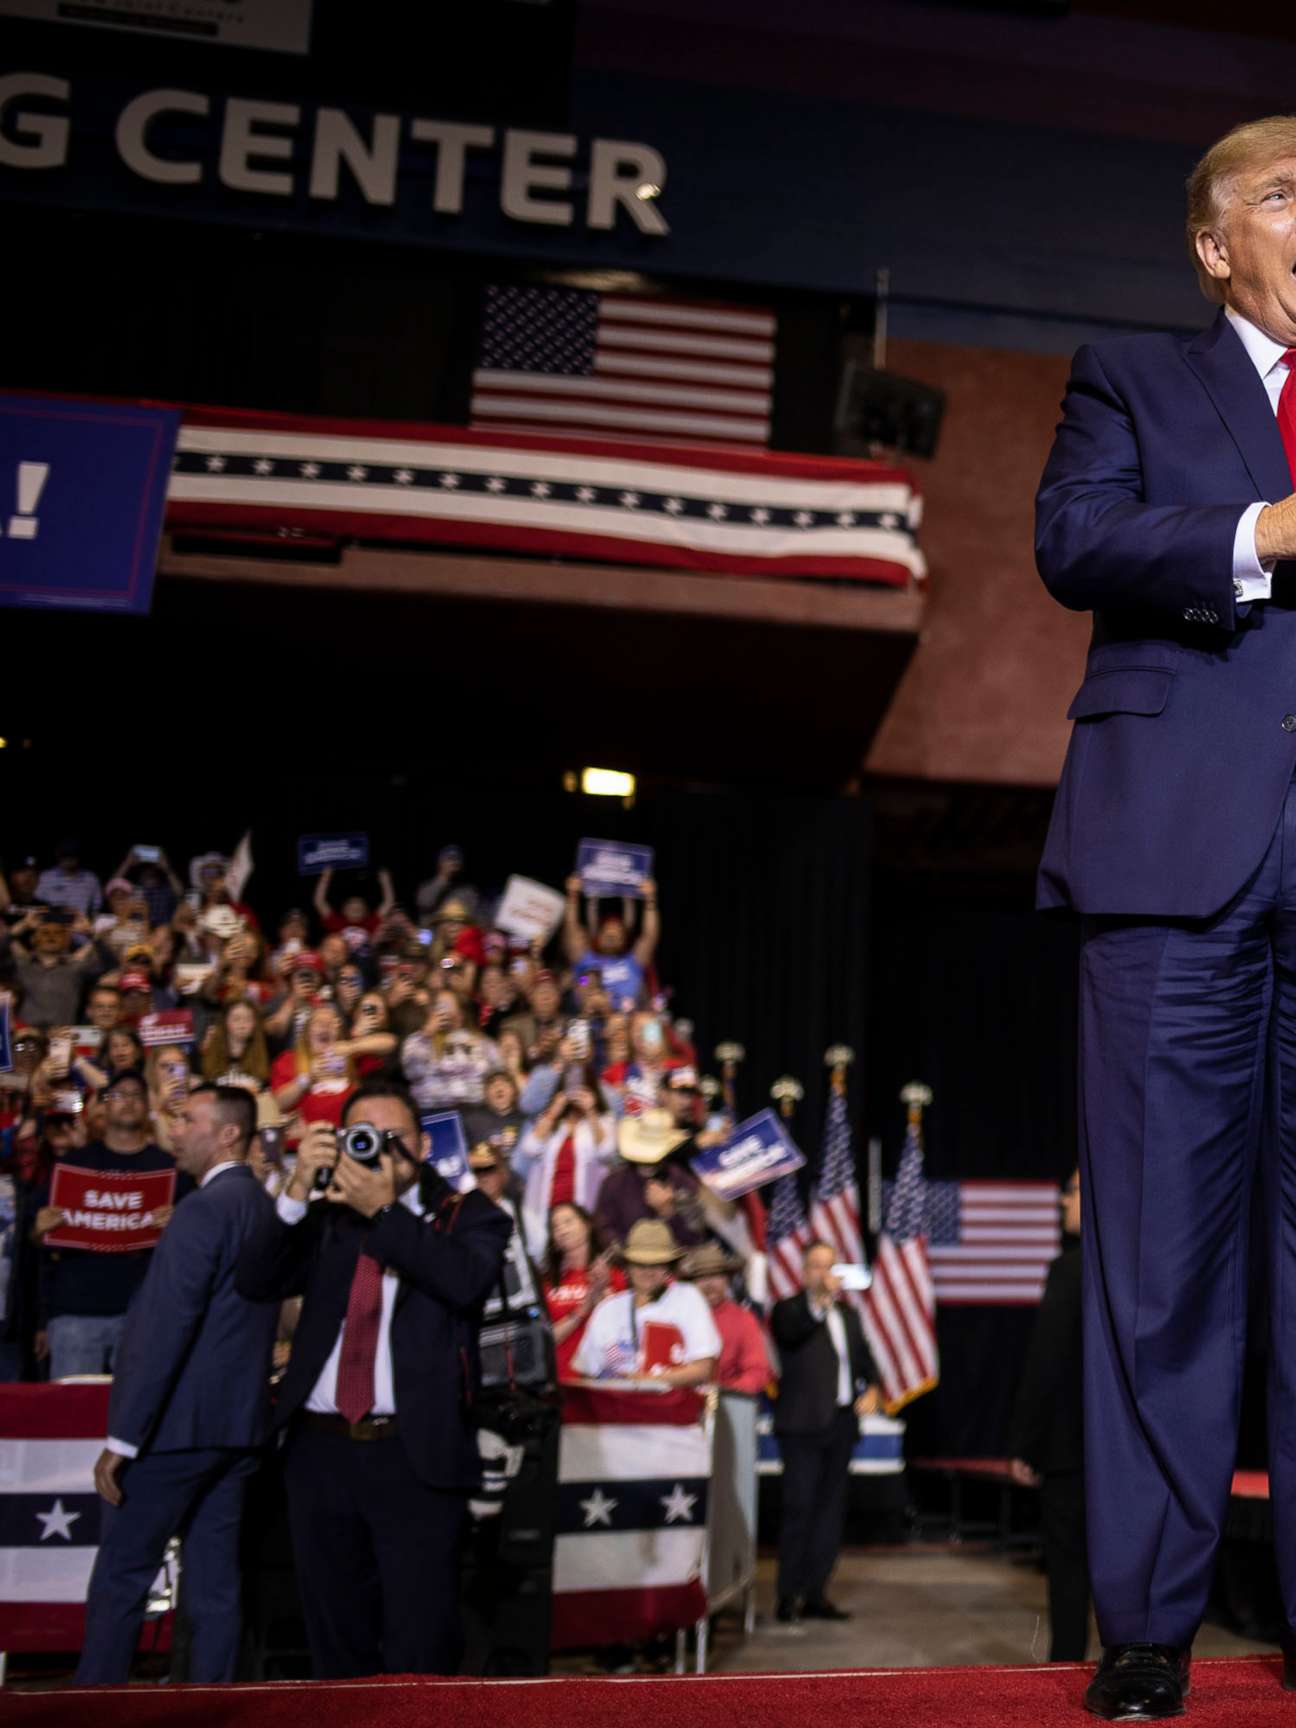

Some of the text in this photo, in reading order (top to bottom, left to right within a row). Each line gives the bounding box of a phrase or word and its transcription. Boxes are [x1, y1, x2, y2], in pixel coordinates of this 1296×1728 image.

[0, 72, 670, 236] G CENTER
[85, 1190, 143, 1209] SAVE
